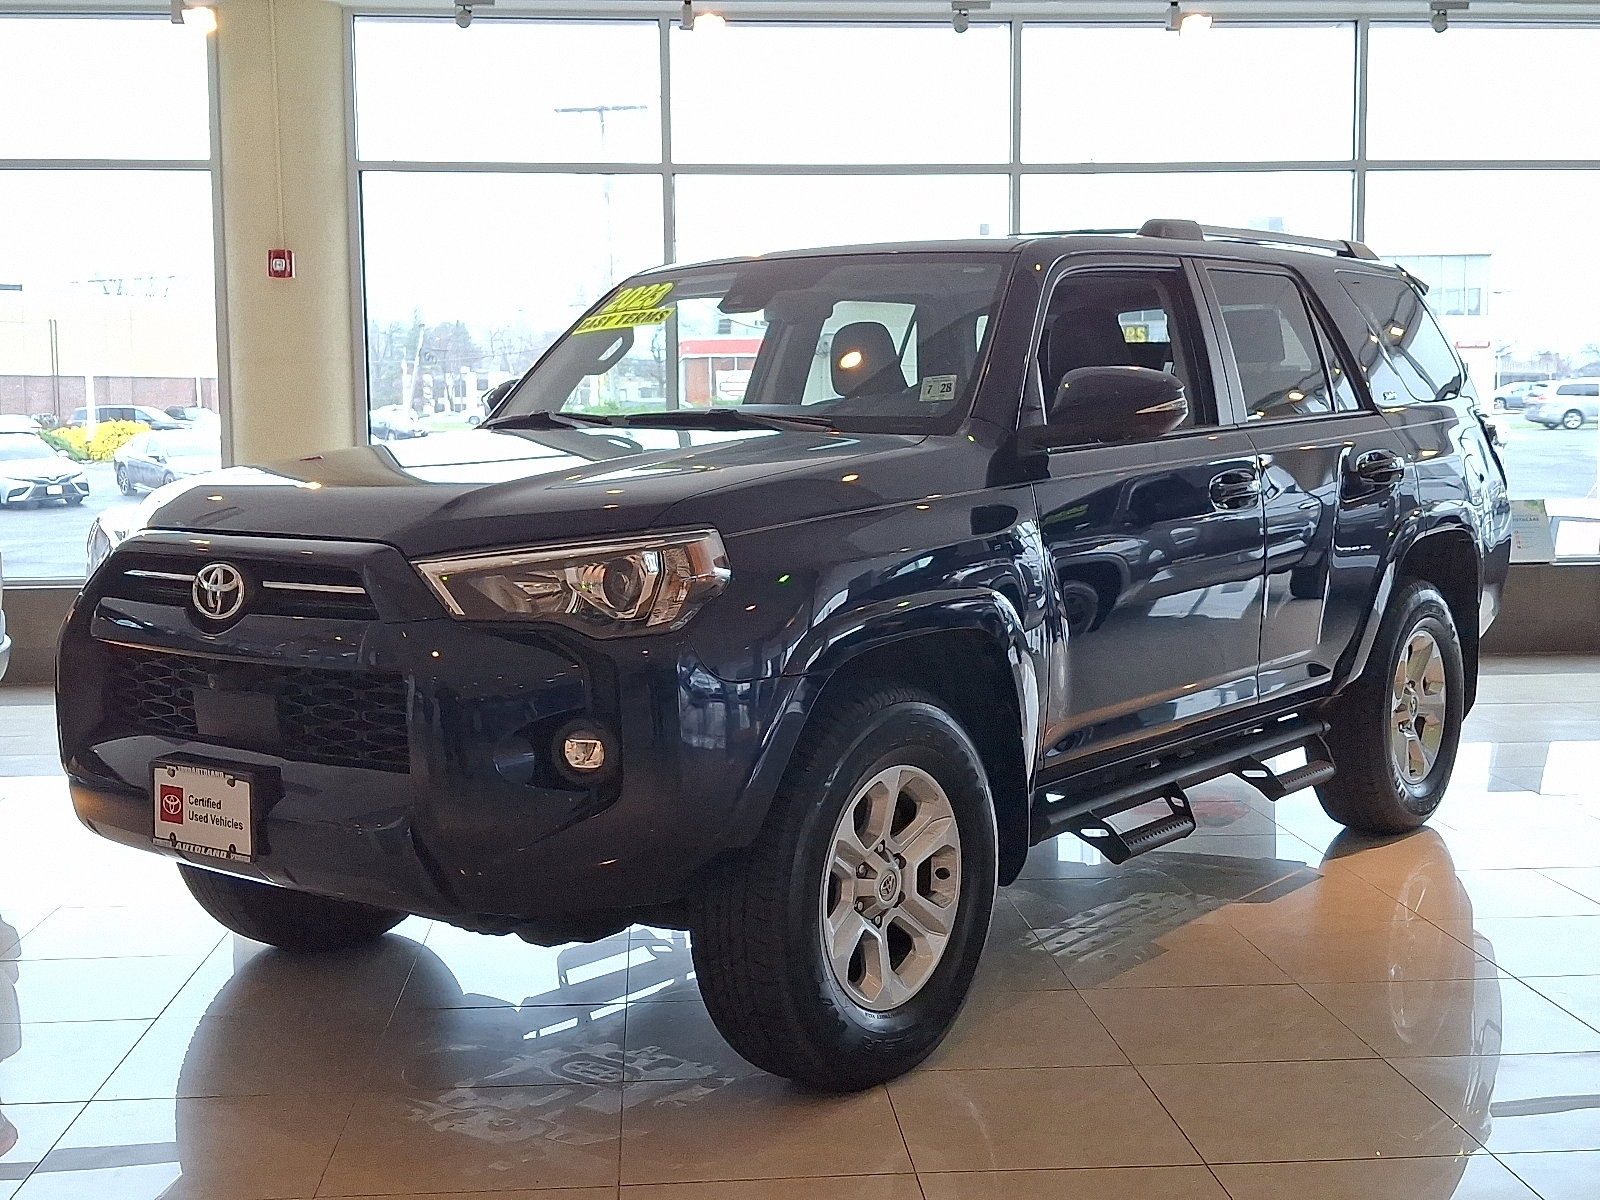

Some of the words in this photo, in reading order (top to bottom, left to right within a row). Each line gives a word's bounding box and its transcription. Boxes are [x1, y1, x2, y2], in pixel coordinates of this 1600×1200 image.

[602, 282, 673, 313] 2023
[577, 316, 615, 331] EASY
[614, 310, 669, 325] TERMS
[927, 384, 933, 394] 7
[940, 383, 952, 393] 28
[188, 795, 221, 809] Certified
[188, 810, 208, 823] Used
[210, 814, 243, 830] Vehicles
[175, 842, 227, 858] AUTOLAND
